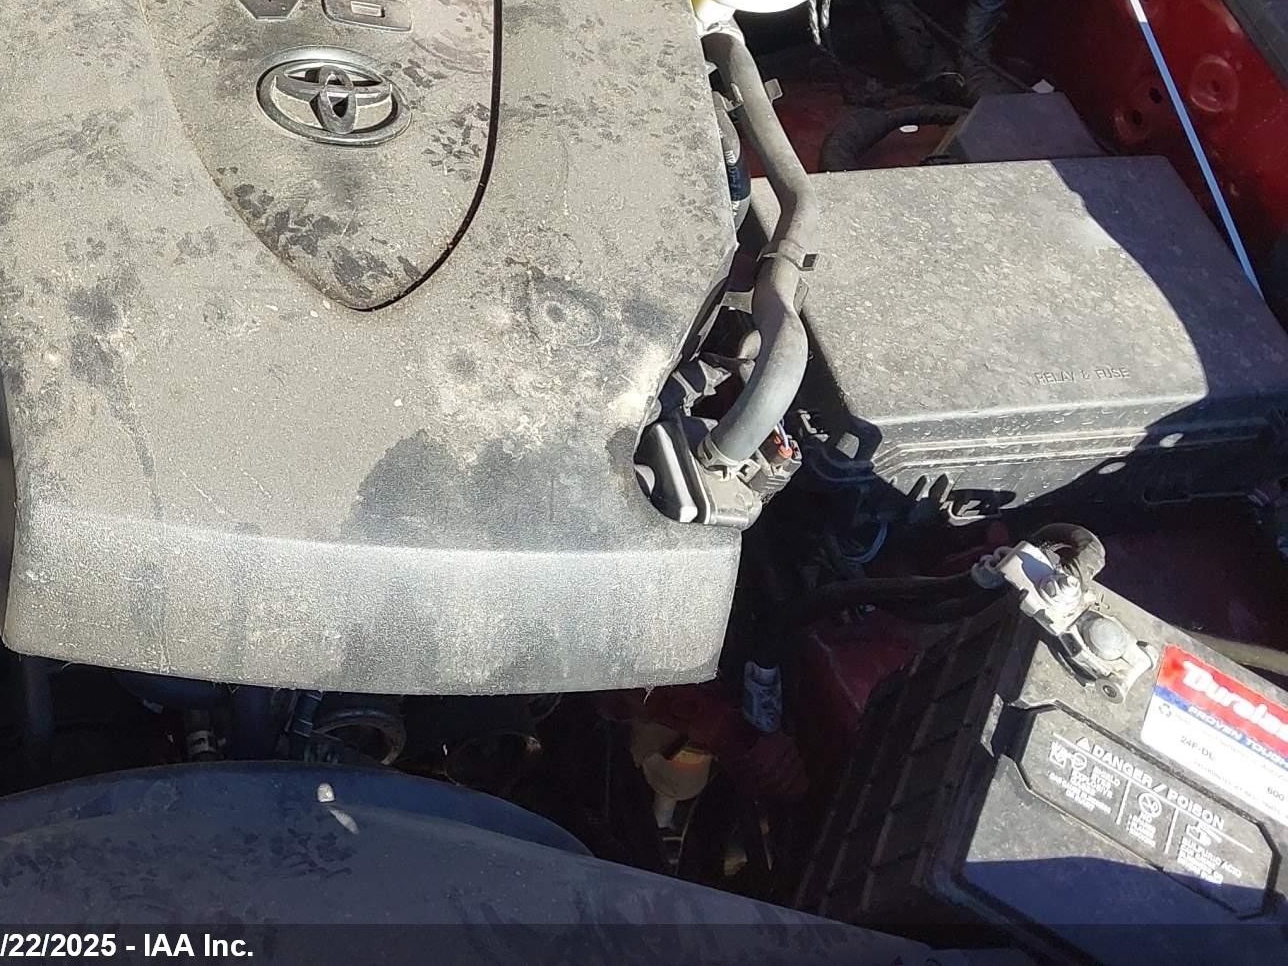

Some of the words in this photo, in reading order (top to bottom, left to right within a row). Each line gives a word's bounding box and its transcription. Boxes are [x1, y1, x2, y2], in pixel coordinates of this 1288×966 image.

[1033, 370, 1075, 385] RELAY
[1095, 367, 1131, 380] FUSE
[1188, 706, 1243, 742] PROVEN
[1092, 744, 1153, 788] DANGER
[1167, 788, 1225, 830] POISON
